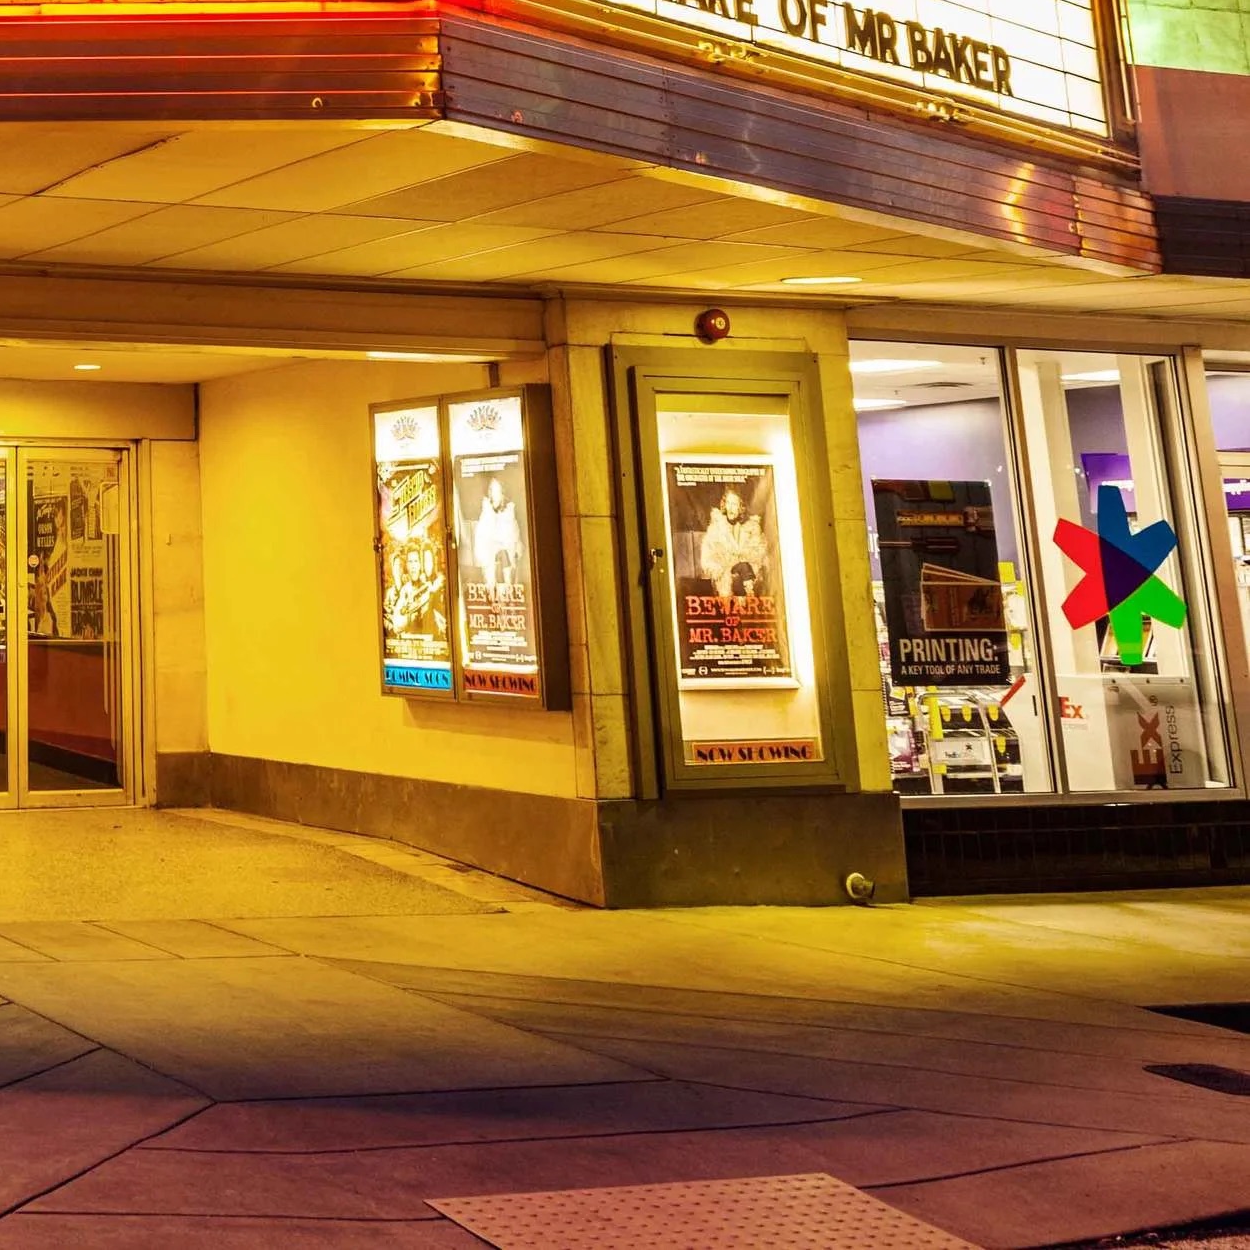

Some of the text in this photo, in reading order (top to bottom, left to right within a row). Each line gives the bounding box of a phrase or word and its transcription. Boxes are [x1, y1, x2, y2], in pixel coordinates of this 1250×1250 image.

[844, 1, 900, 66] MR
[906, 21, 1014, 97] BAKER
[685, 595, 776, 615] BEWARE
[489, 614, 526, 630] BAKER
[725, 616, 740, 627] OF
[689, 627, 778, 643] MR. BAKER
[900, 638, 999, 662] PRINTING:
[901, 664, 1000, 675] A KEY TOOL OF ANY TRADE
[464, 673, 536, 692] NOW SHOWING
[1165, 705, 1183, 774] Express
[697, 744, 814, 762] NOW SHOWING
